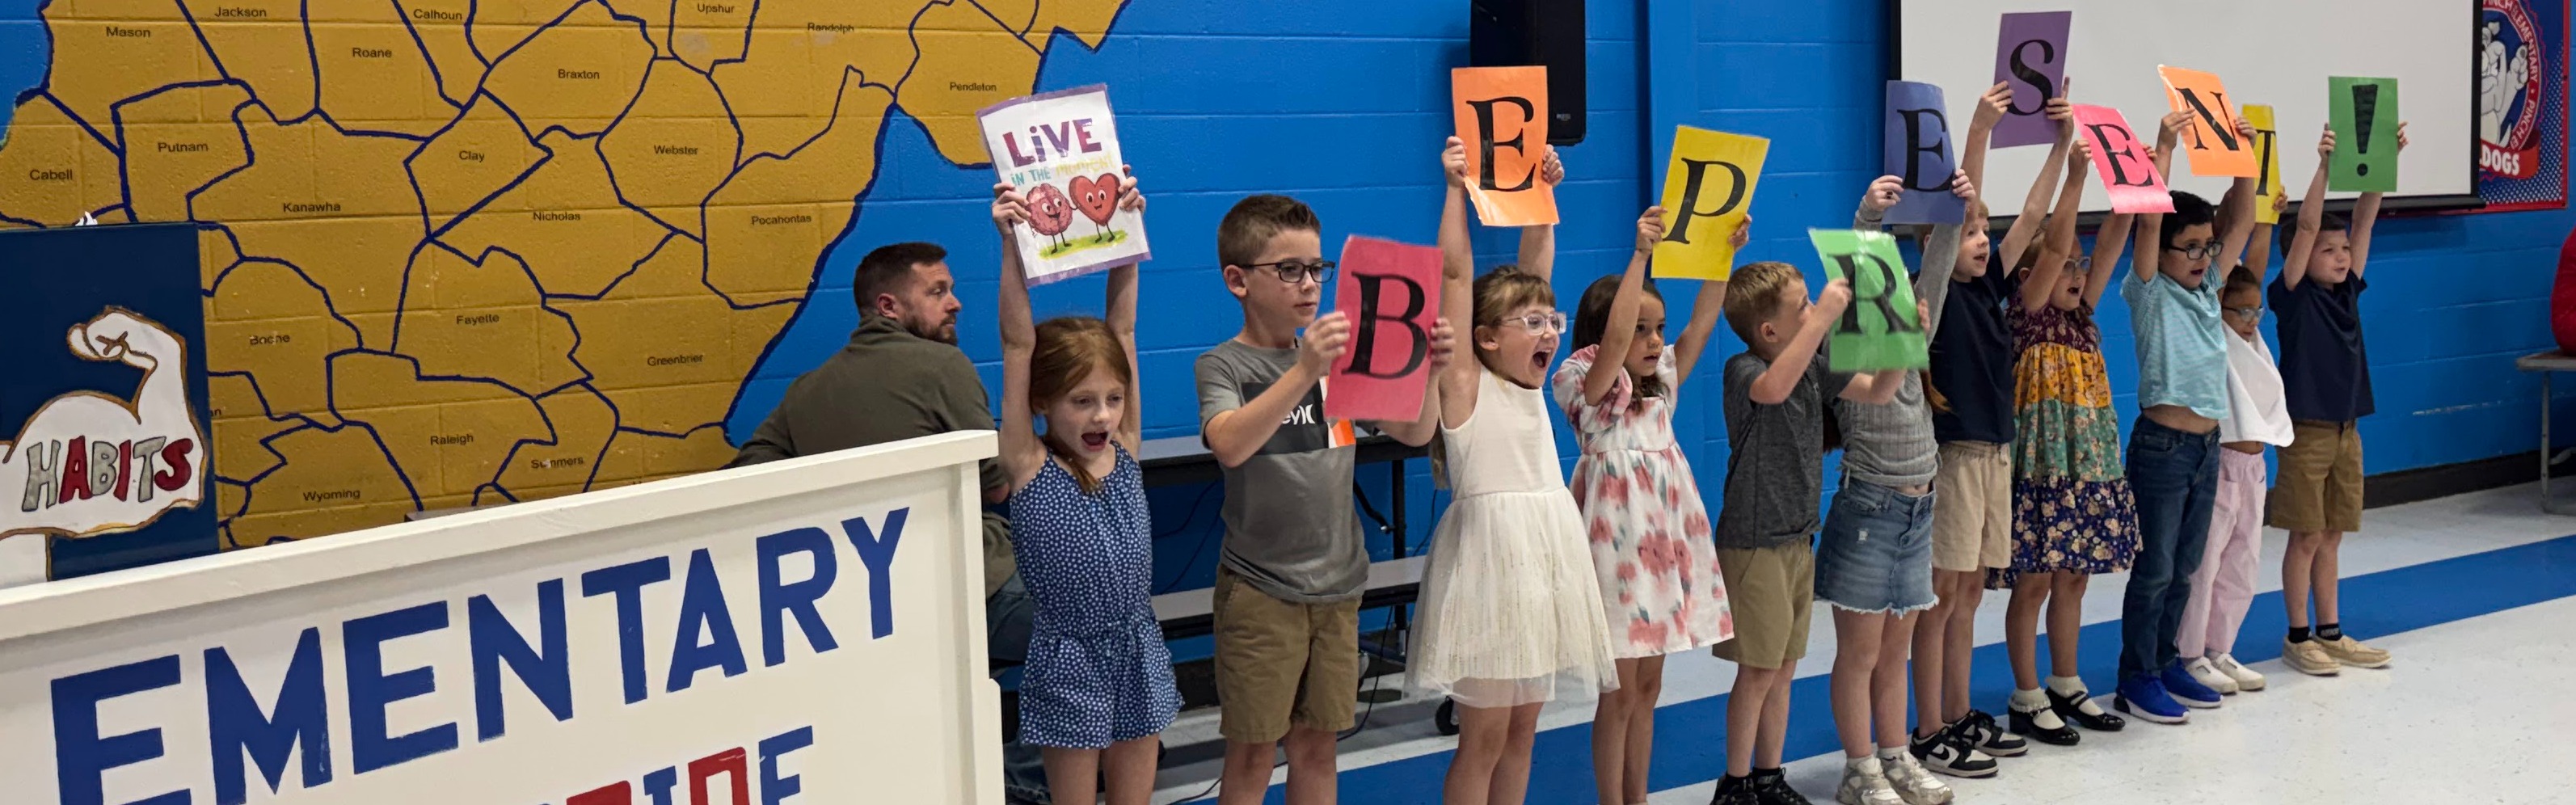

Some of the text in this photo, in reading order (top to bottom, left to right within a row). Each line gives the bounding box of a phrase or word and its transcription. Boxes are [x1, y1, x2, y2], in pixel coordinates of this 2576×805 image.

[214, 6, 267, 18] Jackson
[413, 8, 463, 21] Calhoun
[697, 3, 736, 15] Upshur
[105, 26, 151, 38] Mason
[807, 22, 854, 34] Randolph
[352, 47, 392, 58] Roane
[558, 68, 600, 80] Braxton
[2007, 39, 2054, 116] S
[949, 82, 997, 92] Pendleton
[2176, 87, 2240, 151] N
[2516, 99, 2536, 139] PINCH
[2351, 83, 2378, 177] !
[157, 141, 209, 153] Putnam
[653, 145, 698, 155] Webster
[1466, 96, 1535, 192] E
[1896, 108, 1955, 192] E
[458, 150, 485, 163] Clay
[2084, 123, 2154, 187] E
[2479, 144, 2520, 175] DOGS
[29, 168, 73, 181] Cabell
[1029, 167, 1050, 182] THE
[283, 201, 342, 213] Kanawha
[1663, 157, 1747, 244] P
[533, 210, 581, 221] Nicholas
[751, 213, 812, 226] Pocahontas
[1827, 252, 1920, 335] R
[456, 314, 500, 327] Fayette
[1341, 271, 1427, 380] B
[647, 353, 704, 367] Greenbrier
[430, 432, 474, 446] Raleigh
[21, 435, 194, 512] HABITS
[302, 489, 360, 503] Wyoming
[50, 507, 910, 805] EMENTARY
